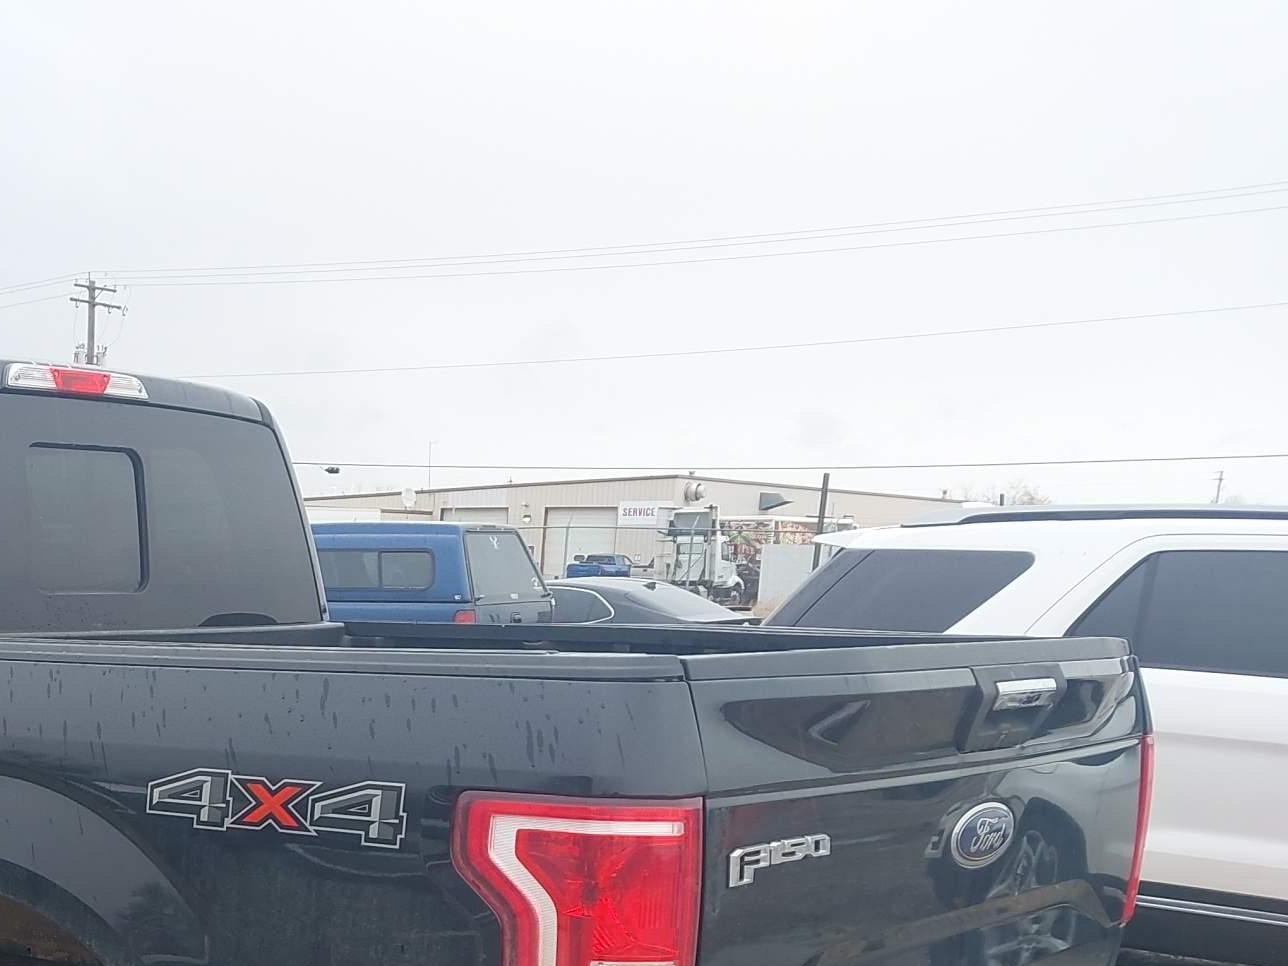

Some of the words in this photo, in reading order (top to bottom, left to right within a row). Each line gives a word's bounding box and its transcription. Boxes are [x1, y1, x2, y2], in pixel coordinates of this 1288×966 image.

[622, 507, 656, 517] SERVICE
[970, 816, 1009, 853] Ford
[729, 833, 831, 887] F150
